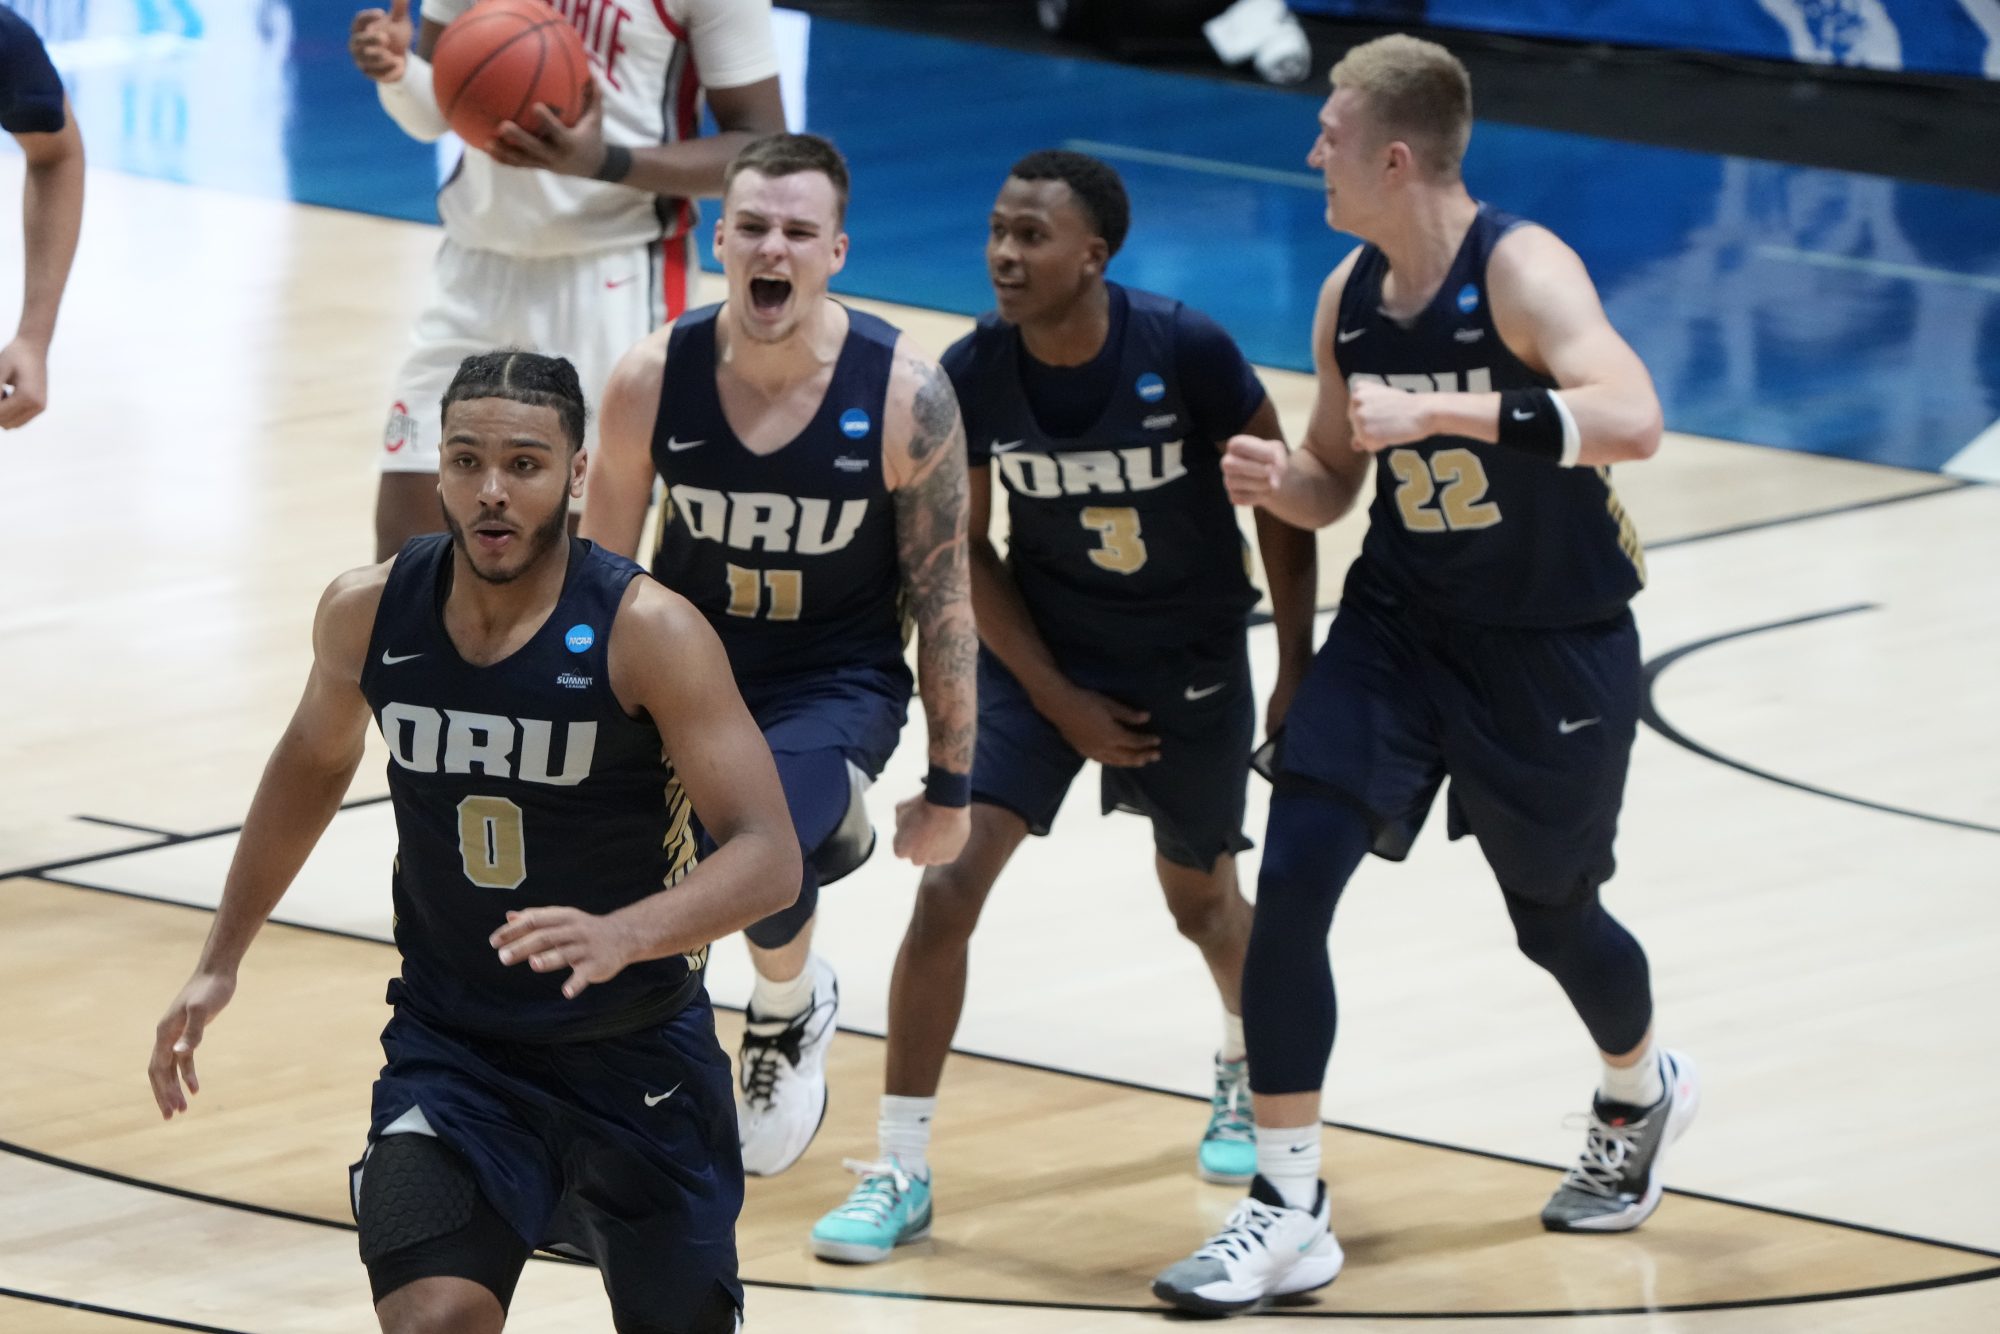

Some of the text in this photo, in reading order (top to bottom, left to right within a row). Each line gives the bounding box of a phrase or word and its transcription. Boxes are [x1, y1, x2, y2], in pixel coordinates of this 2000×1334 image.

[1000, 439, 1188, 498] ORU
[1388, 448, 1502, 532] 22
[671, 484, 869, 556] ORU
[1079, 506, 1148, 575] 3
[726, 561, 802, 621] 11
[557, 676, 593, 685] SUMMIT
[382, 701, 598, 786] ORU
[456, 795, 527, 889] 0
